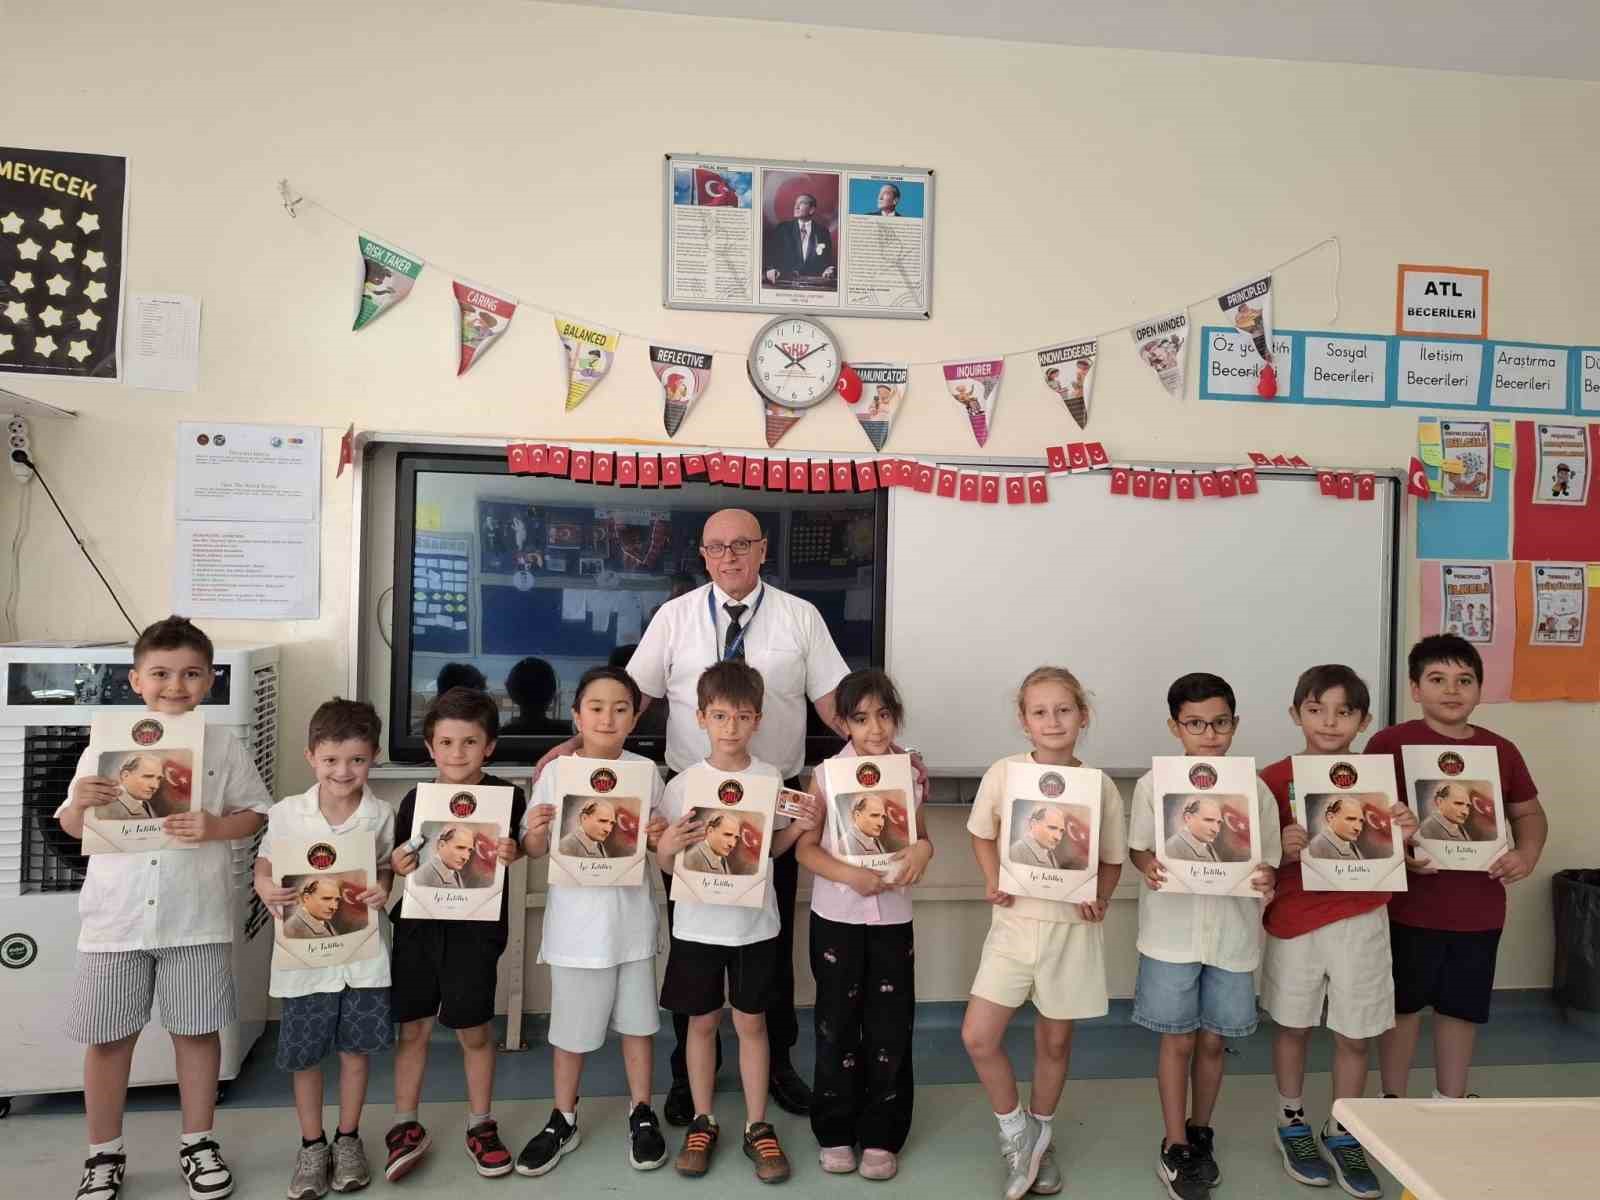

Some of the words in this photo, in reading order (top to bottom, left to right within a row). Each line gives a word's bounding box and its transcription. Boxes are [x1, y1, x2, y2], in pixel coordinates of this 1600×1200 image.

[0, 160, 98, 201] MEYECEK
[364, 242, 384, 260] RISK
[384, 252, 412, 274] TAKER
[1226, 282, 1267, 307] PRINCIPLED
[1424, 281, 1462, 297] ATL
[466, 290, 497, 312] CARING
[1407, 306, 1476, 320] BECERİLERİ
[563, 323, 607, 346] BALANCED
[777, 328, 784, 336] 11
[793, 324, 801, 334] 12
[1136, 326, 1156, 340] OPEN
[1157, 315, 1186, 336] MINDED
[765, 339, 773, 349] 10
[1213, 333, 1234, 351] Öz
[1240, 341, 1290, 358] ytim
[1326, 342, 1368, 363] Sosyal
[657, 349, 704, 368] REFLECTIVE
[1420, 343, 1464, 363] İletişim
[1496, 350, 1557, 368] Araştırma
[857, 370, 907, 381] MMUNICATOR
[956, 364, 992, 378] INQUIRER
[1212, 360, 1278, 377] Becerili
[1313, 366, 1374, 383] Becerileri
[1407, 370, 1468, 387] Becerileri
[1495, 374, 1551, 391] Becerileri
